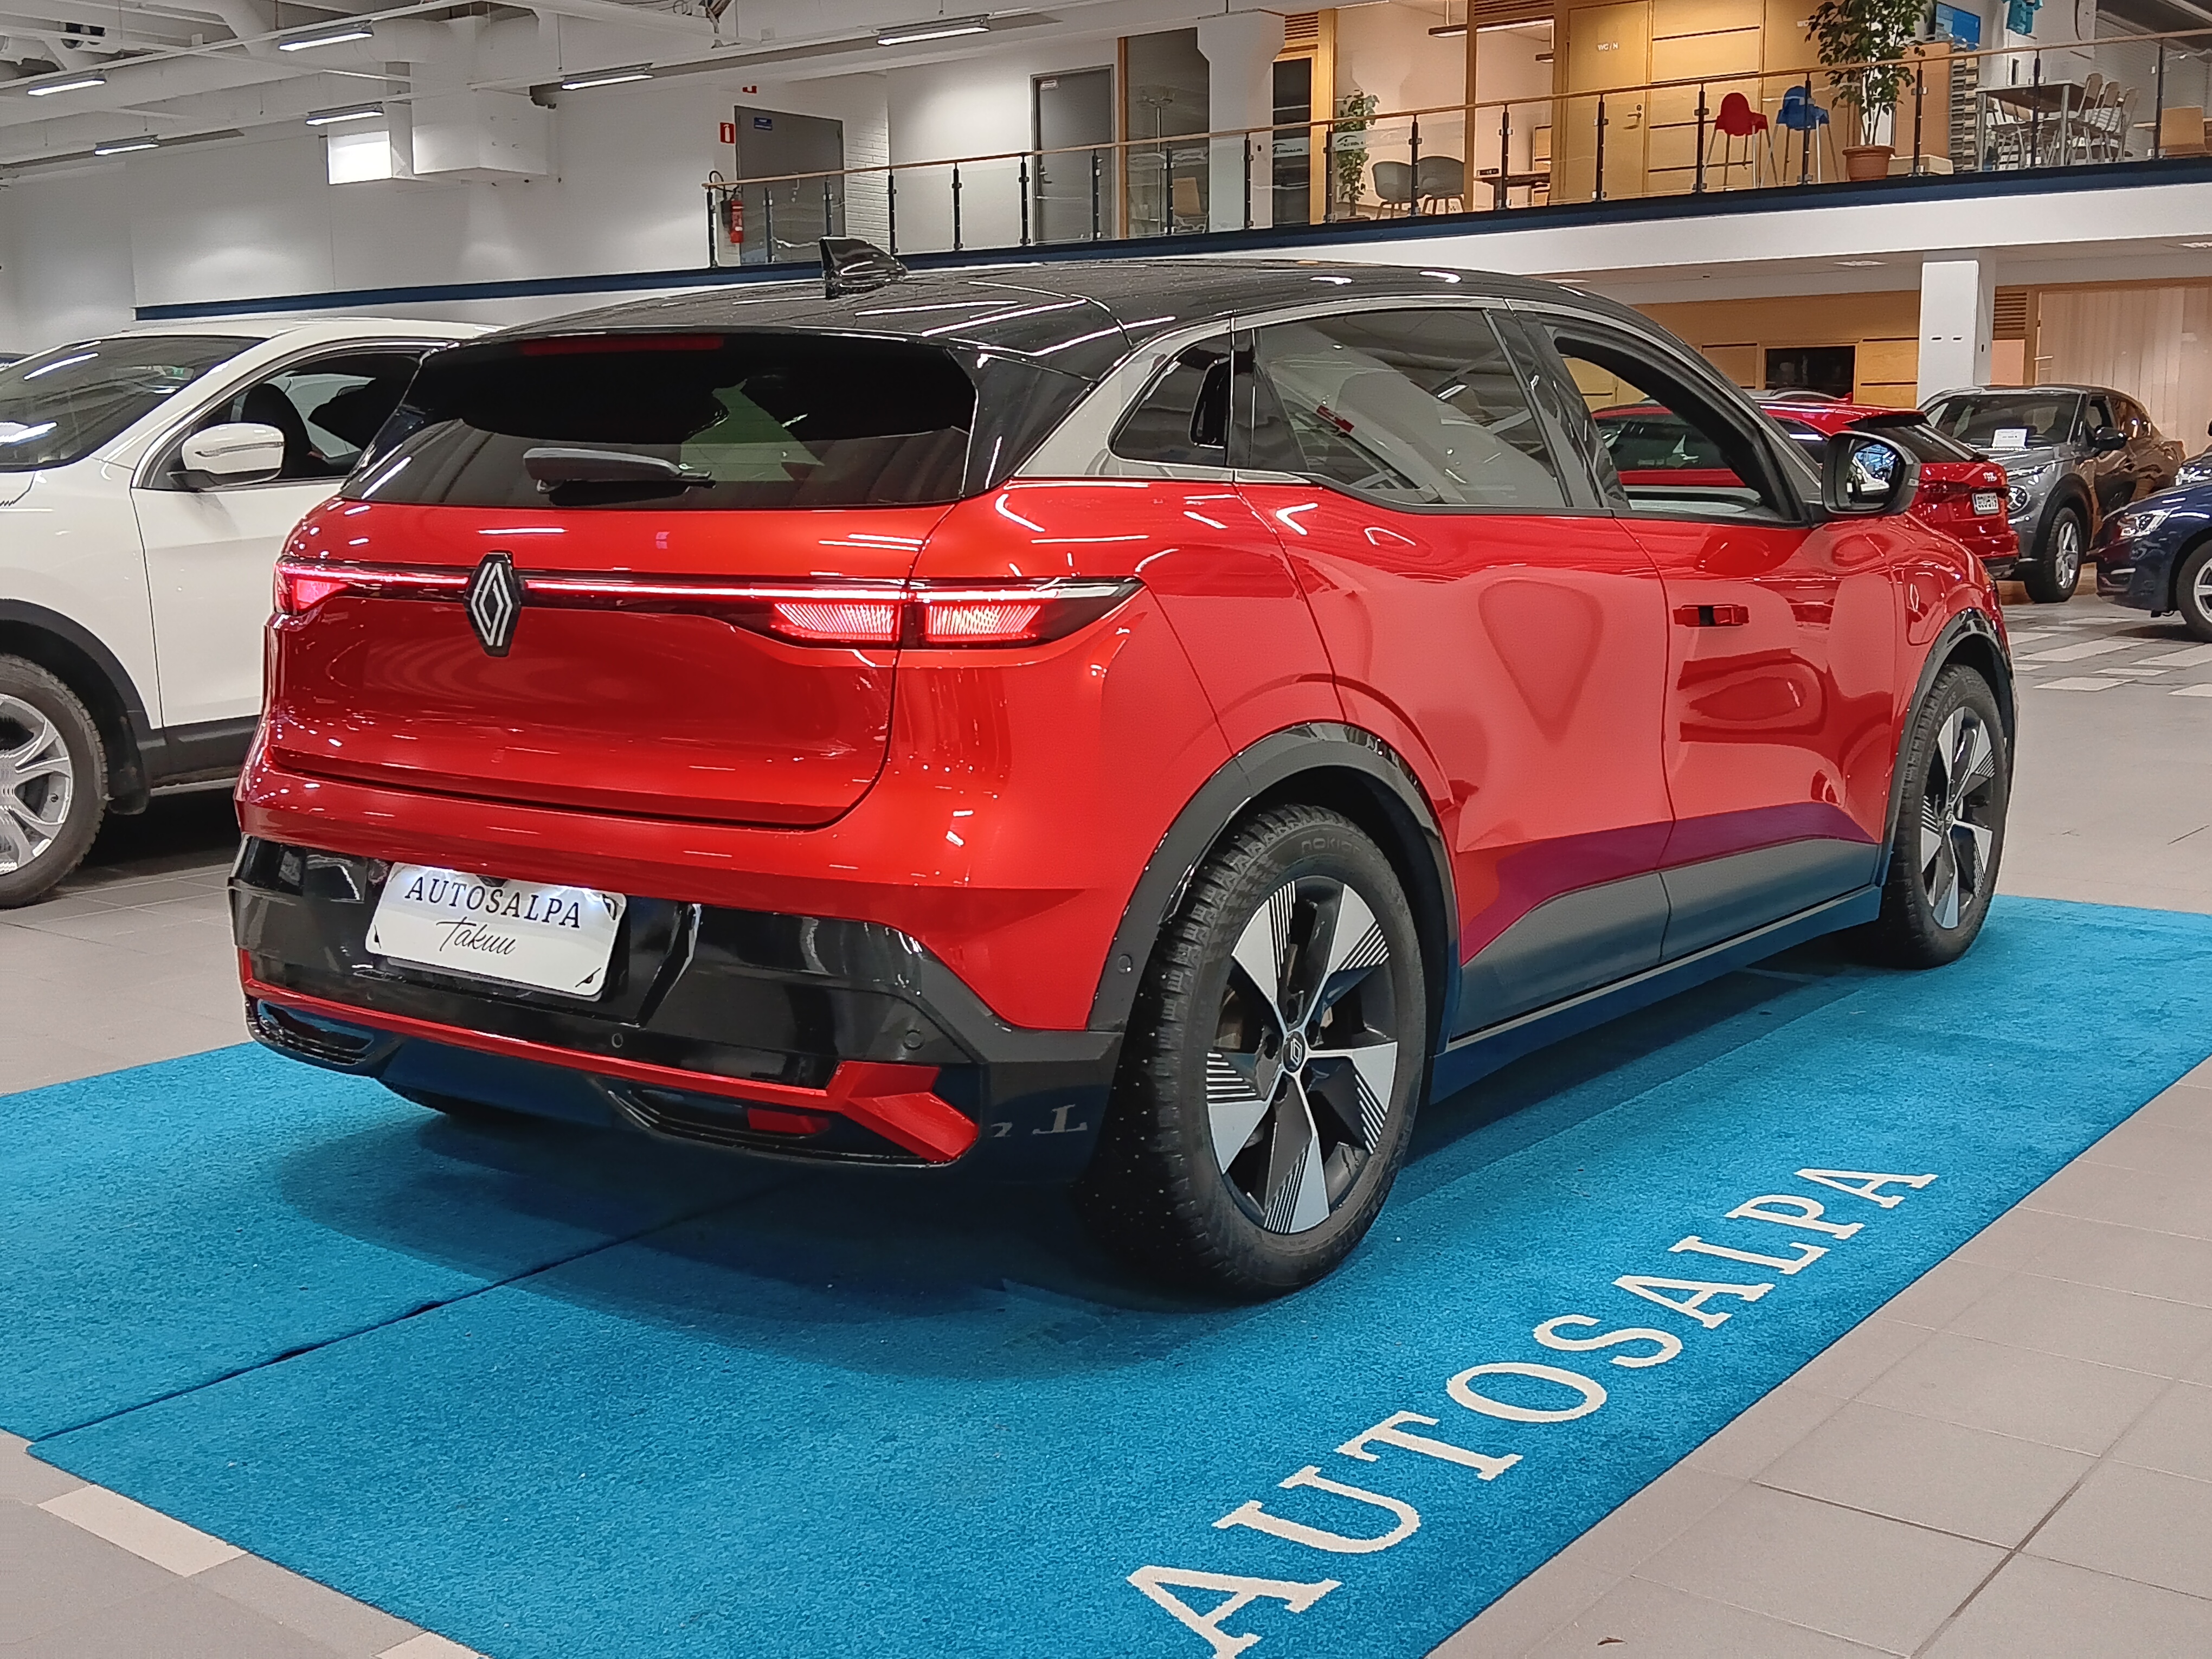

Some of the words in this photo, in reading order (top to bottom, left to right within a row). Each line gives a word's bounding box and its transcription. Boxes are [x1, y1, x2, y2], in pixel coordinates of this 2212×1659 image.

[404, 876, 580, 928] AUTOSALPA
[436, 916, 516, 955] Takuu
[1127, 1167, 1938, 1659] AUTOSALPA
